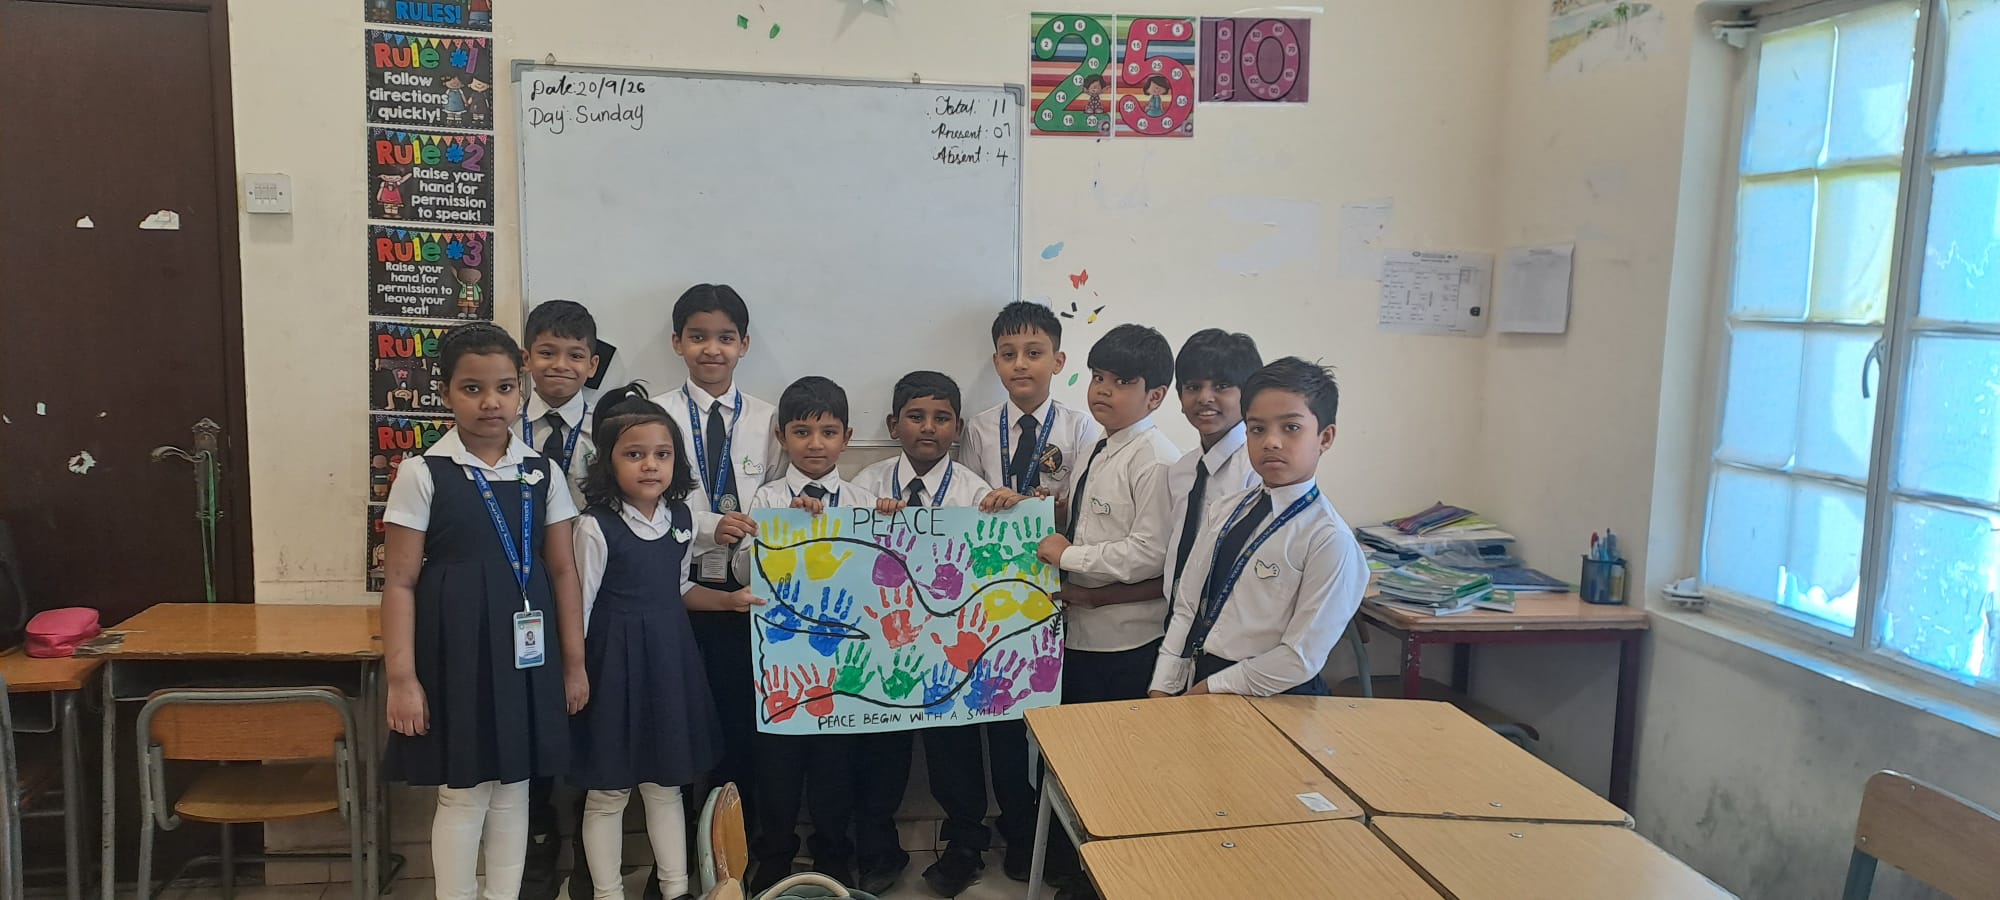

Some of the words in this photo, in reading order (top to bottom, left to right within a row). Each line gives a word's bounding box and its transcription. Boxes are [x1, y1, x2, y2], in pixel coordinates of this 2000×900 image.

[396, 1, 462, 24] RULES!
[374, 42, 440, 69] Rule
[450, 47, 479, 74] #1
[383, 71, 433, 87] Follow
[1035, 14, 1111, 132] 2
[1119, 18, 1194, 135] 5
[369, 87, 449, 105] directions
[378, 105, 441, 123] quickly!
[575, 104, 644, 130] Sunday
[992, 98, 1006, 117] 11
[375, 139, 441, 165] Rule
[446, 143, 485, 172] #2
[996, 147, 1008, 167] 4
[413, 166, 449, 181] Raise
[453, 170, 485, 183] your
[419, 180, 455, 194] hand
[457, 182, 478, 195] for
[411, 194, 487, 209] permission
[418, 206, 433, 219] to
[435, 208, 481, 222] speak!
[376, 236, 441, 262] Rule
[446, 240, 483, 267] #3
[385, 261, 415, 272] Raise
[418, 263, 444, 276] your
[390, 272, 419, 283] hand
[421, 273, 439, 284] for
[377, 283, 438, 294] permission
[440, 285, 453, 295] to
[384, 293, 417, 304] leave
[420, 295, 445, 307] your
[401, 304, 429, 315] seat!
[377, 333, 440, 359] Rule
[377, 425, 441, 449] Rule
[852, 507, 946, 537] PEACE
[817, 715, 856, 731] PEACE
[863, 713, 901, 725] BEGIN
[910, 712, 943, 723] WITH
[950, 712, 958, 720] A
[966, 705, 1011, 720] SMILE
